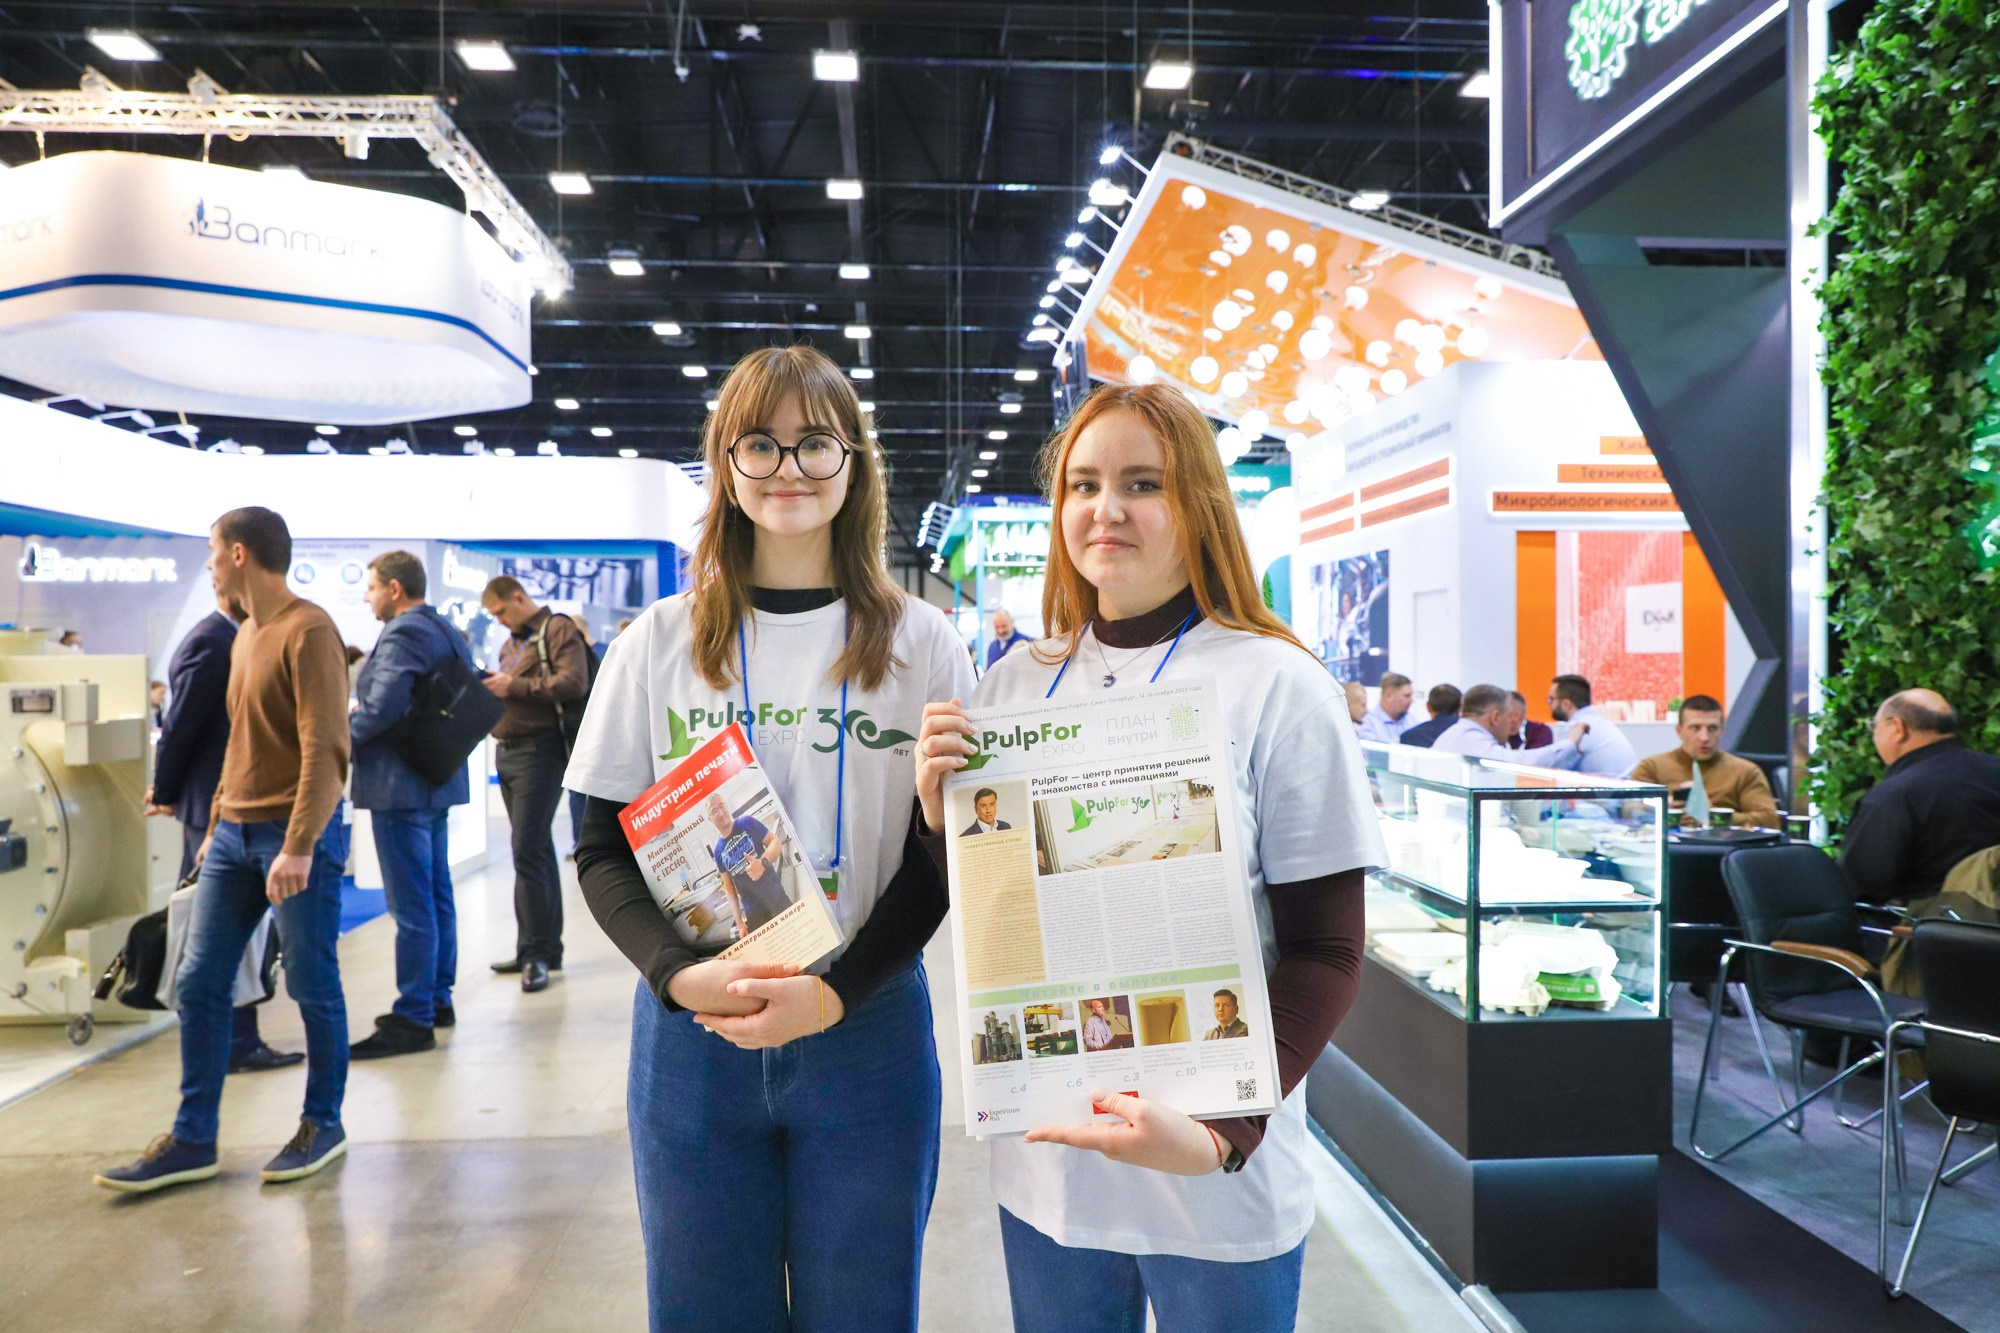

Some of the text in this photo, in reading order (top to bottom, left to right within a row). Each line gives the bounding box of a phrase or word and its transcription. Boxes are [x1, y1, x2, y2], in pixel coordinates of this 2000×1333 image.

[198, 205, 384, 261] Banmark
[1496, 493, 1669, 510] Микробиологический
[1174, 686, 1188, 694] 2023
[689, 702, 807, 732] PulpFor
[1106, 713, 1156, 732] ПЛАН
[758, 728, 807, 746] EXPO
[983, 722, 1082, 751] PulpFor
[1107, 730, 1158, 747] внутри
[1042, 741, 1085, 759] EXPO
[1031, 774, 1069, 787] PulpFor
[1082, 770, 1112, 780] центр
[1114, 762, 1162, 776] принятия
[1164, 754, 1211, 769] решений
[631, 778, 694, 831] Индустрия
[695, 744, 739, 782] печати
[1041, 782, 1099, 796] знакомства
[1109, 770, 1179, 786] инновациями
[1086, 796, 1129, 814] PulpFor
[647, 814, 705, 862] Многогранный
[651, 844, 683, 873] раскрой
[661, 855, 686, 878] iECHO
[734, 921, 779, 953] материалах
[780, 902, 806, 922] номера
[1020, 984, 1085, 999] Читайте
[1093, 983, 1101, 991] в
[989, 1106, 1021, 1117] ExpoVision
